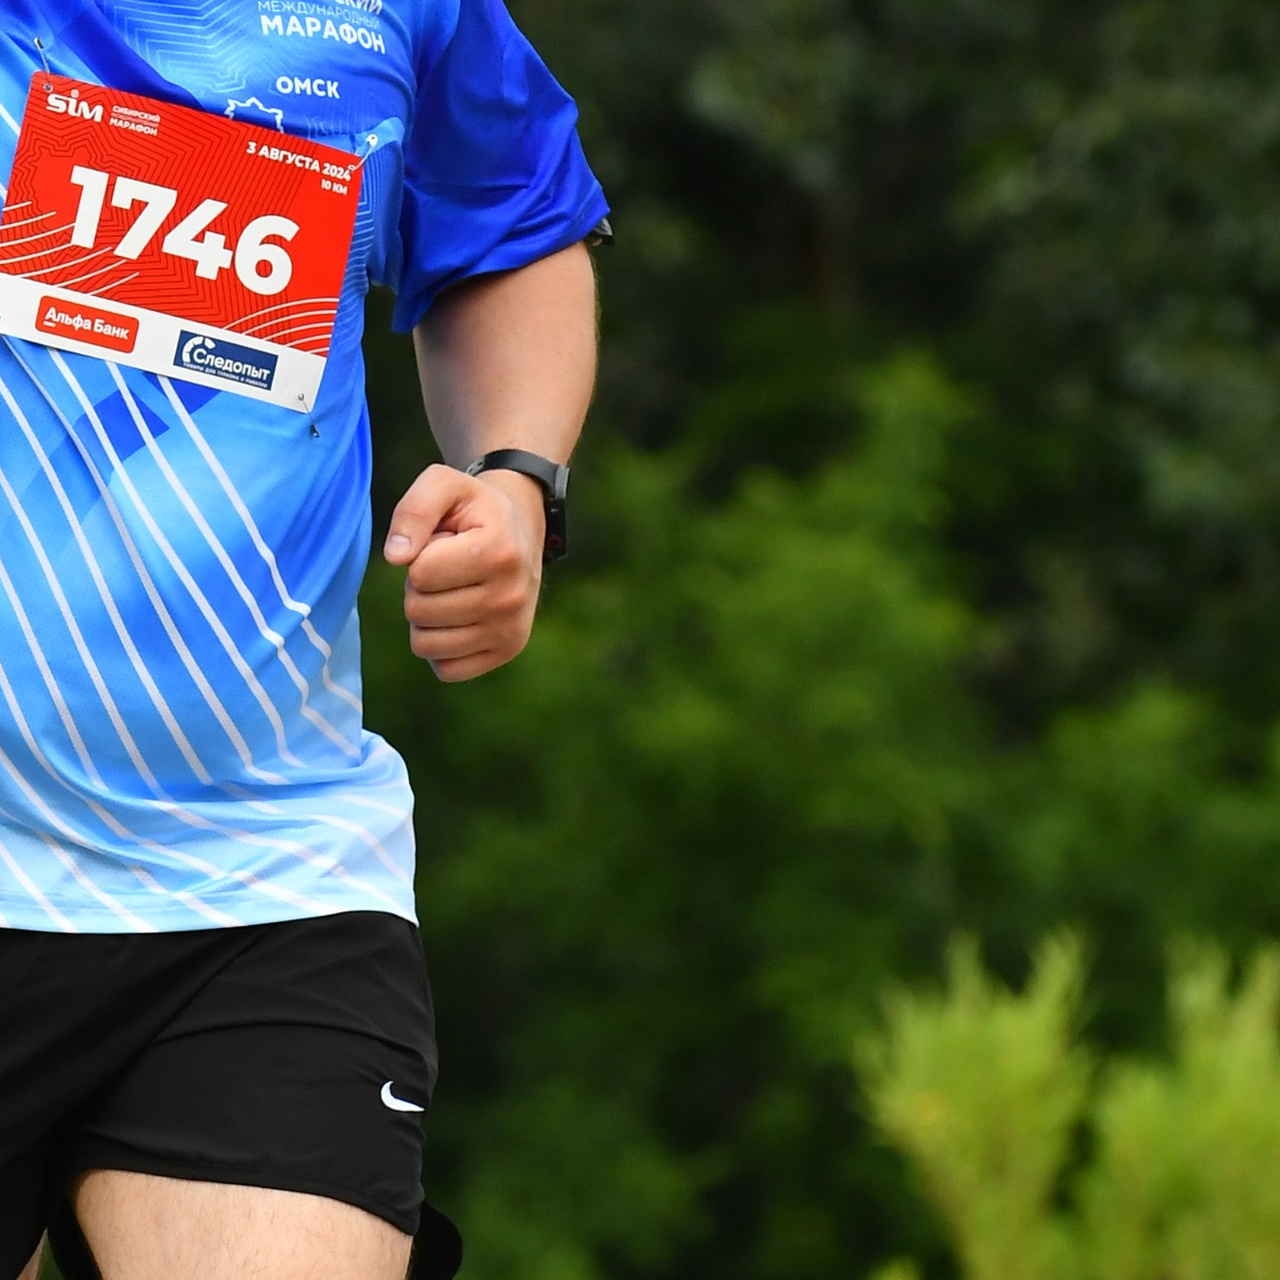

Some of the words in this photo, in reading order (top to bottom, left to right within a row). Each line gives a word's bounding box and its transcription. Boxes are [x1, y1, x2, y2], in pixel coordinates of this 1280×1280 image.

[260, 14, 386, 54] МАРАФОН
[275, 75, 341, 99] ОМСК
[109, 117, 158, 136] МАРАФОН
[246, 141, 257, 154] 3
[258, 145, 320, 173] АВГУСТА
[322, 162, 351, 182] 2024
[321, 178, 332, 190] 10
[70, 164, 300, 296] 1746
[43, 306, 93, 331] Альфа
[93, 318, 130, 340] Банк
[192, 348, 271, 381] Следопыт
